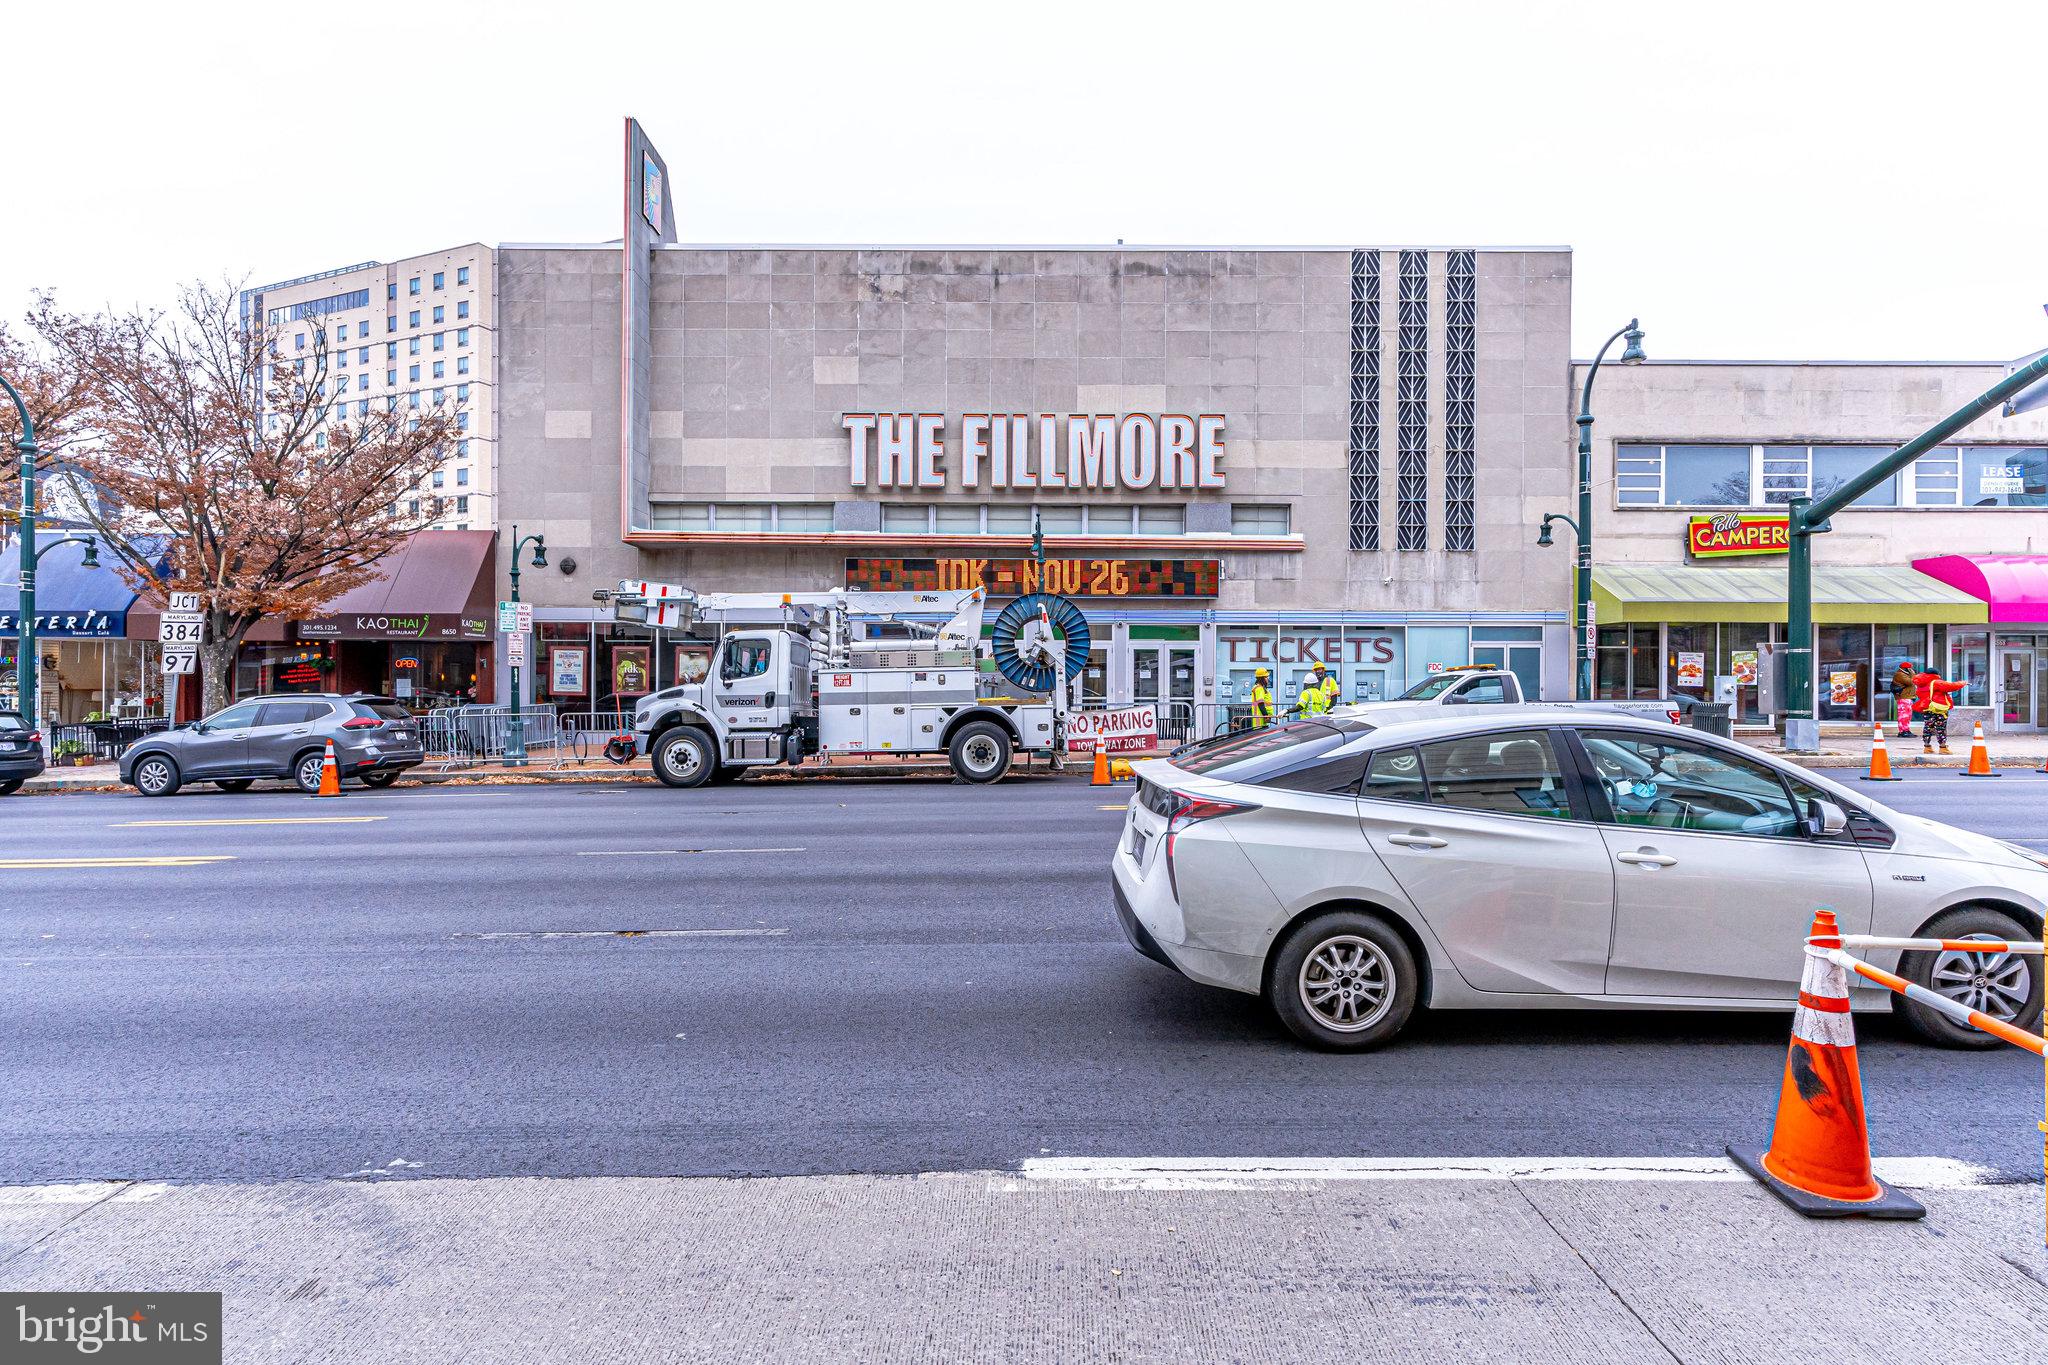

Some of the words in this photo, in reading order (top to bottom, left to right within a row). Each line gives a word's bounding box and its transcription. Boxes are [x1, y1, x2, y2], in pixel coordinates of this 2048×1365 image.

[842, 413, 946, 488] THE
[962, 413, 1226, 489] FILLMORE
[1983, 466, 2021, 477] LEASE
[1709, 512, 1741, 533] Pollo
[936, 559, 988, 592] IDK
[1023, 559, 1081, 594] NOV
[1090, 560, 1129, 595] 26
[173, 595, 197, 608] JCT
[921, 595, 939, 603] Altec
[0, 609, 108, 630] ETERIA
[162, 624, 200, 641] 384
[947, 632, 966, 641] Altec
[1220, 636, 1394, 664] TICKETS
[165, 655, 193, 672] 97
[395, 659, 417, 668] OPEN
[1428, 663, 1442, 671] FDC
[725, 697, 756, 706] verizon
[1067, 714, 1089, 734] NO
[1093, 710, 1153, 733] PARKING
[1124, 737, 1146, 749] ZONE
